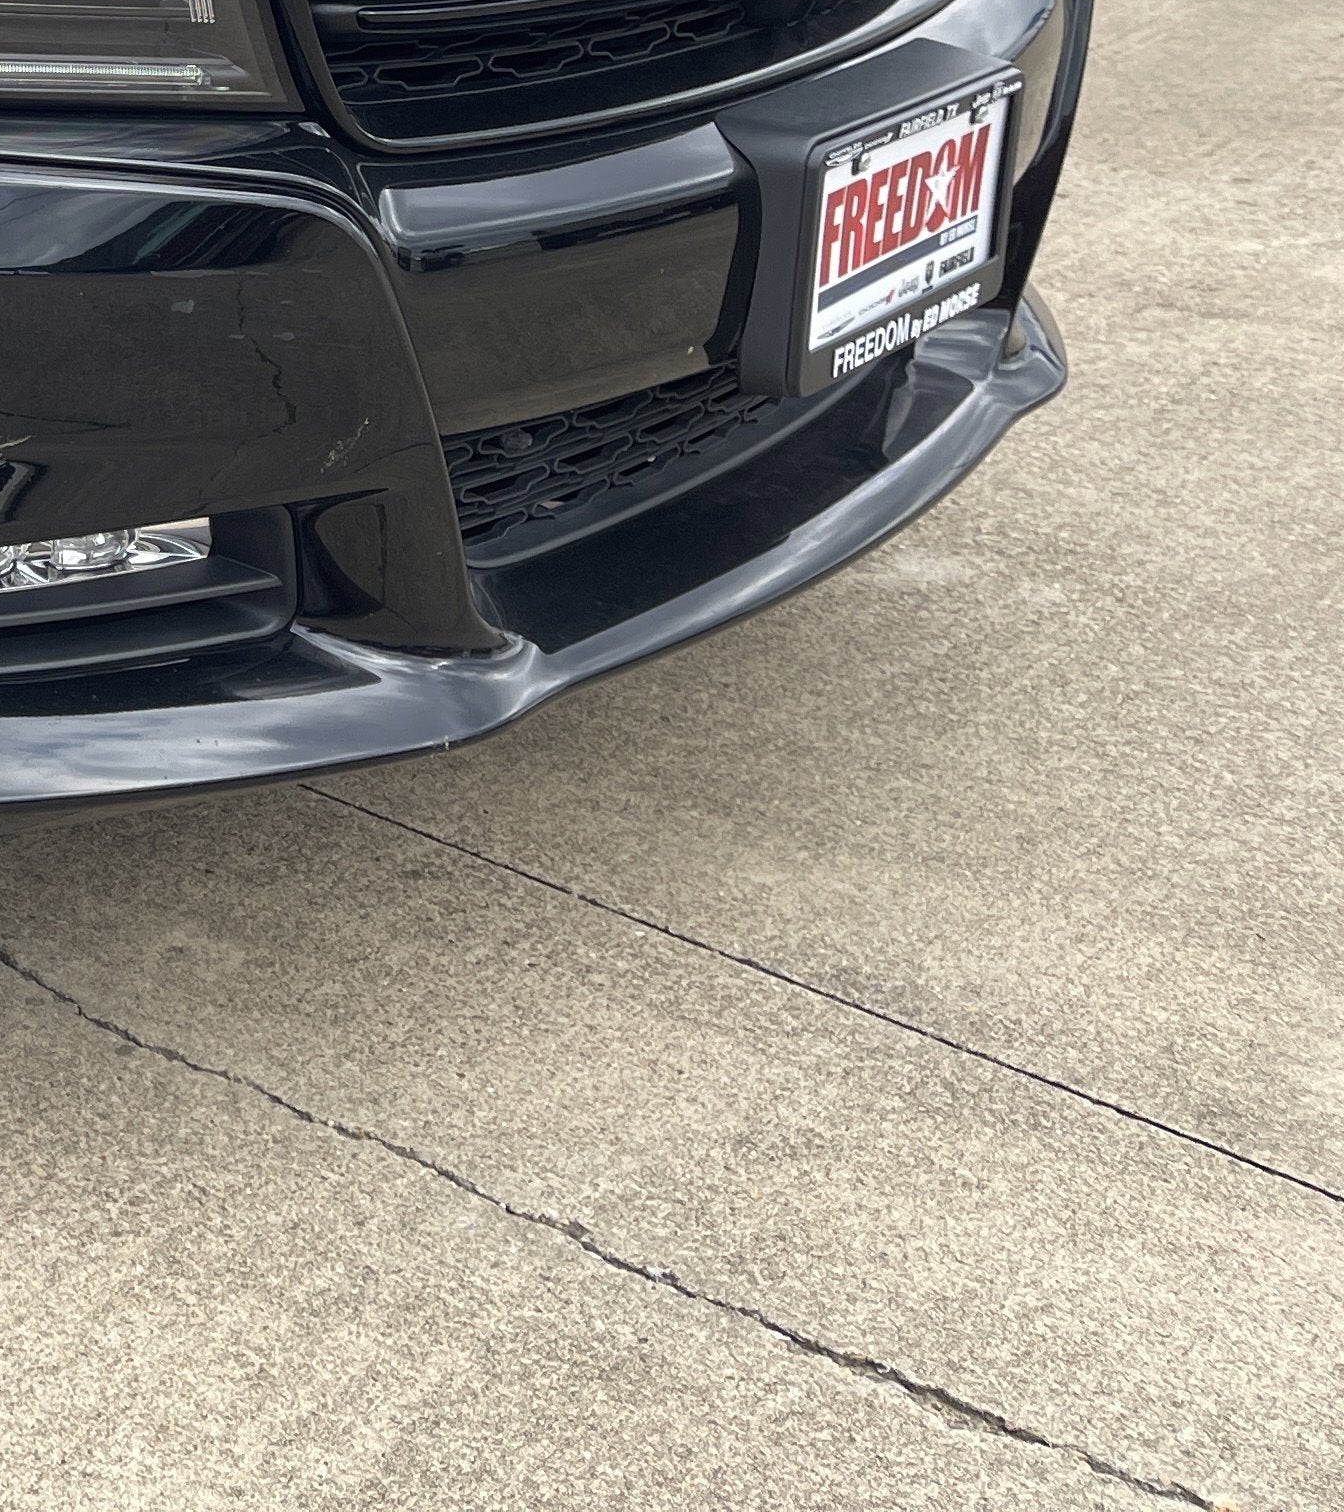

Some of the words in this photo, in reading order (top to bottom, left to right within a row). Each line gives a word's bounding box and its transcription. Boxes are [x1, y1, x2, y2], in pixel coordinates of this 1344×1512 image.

[819, 123, 992, 288] FREEDOM
[832, 313, 911, 378] FREEDOM
[922, 304, 940, 332] ED
[938, 282, 981, 324] MORSE
